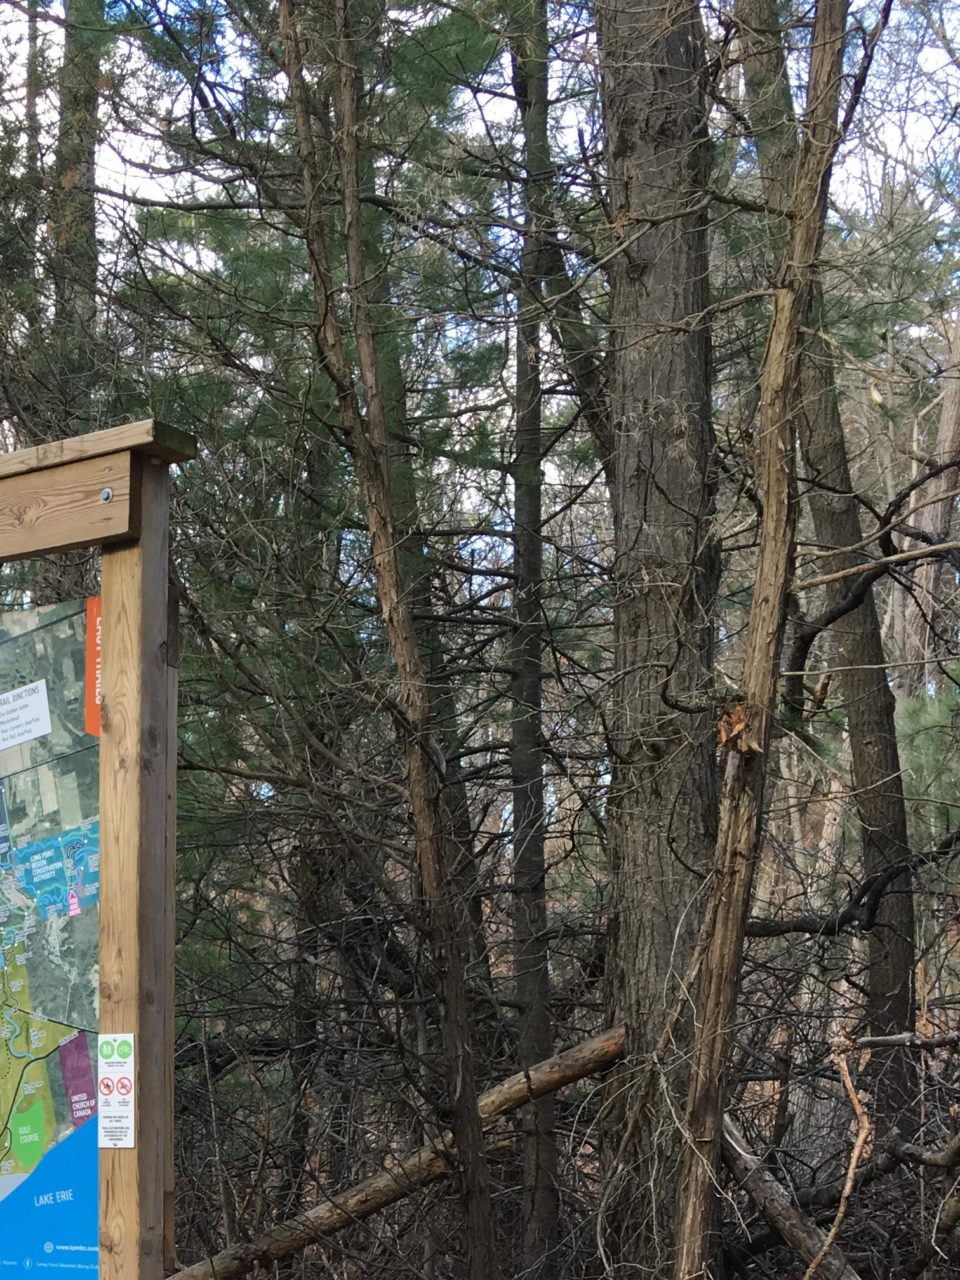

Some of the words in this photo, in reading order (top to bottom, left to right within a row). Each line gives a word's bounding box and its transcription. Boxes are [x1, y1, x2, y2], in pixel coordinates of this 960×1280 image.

[12, 685, 40, 703] JUNCTIONS
[30, 853, 42, 862] LONG
[41, 849, 55, 858] POINT
[31, 860, 47, 869] REGION
[32, 861, 63, 876] CONSERVATION
[33, 870, 56, 883] AUTHORITY
[71, 1092, 88, 1102] UNITED
[72, 1100, 90, 1111] CHURCH
[73, 1109, 92, 1118] CANADA
[18, 1125, 31, 1135] GOLF
[19, 1133, 40, 1144] COURSE
[34, 1192, 55, 1207] LAKE
[55, 1189, 74, 1202] ERIE
